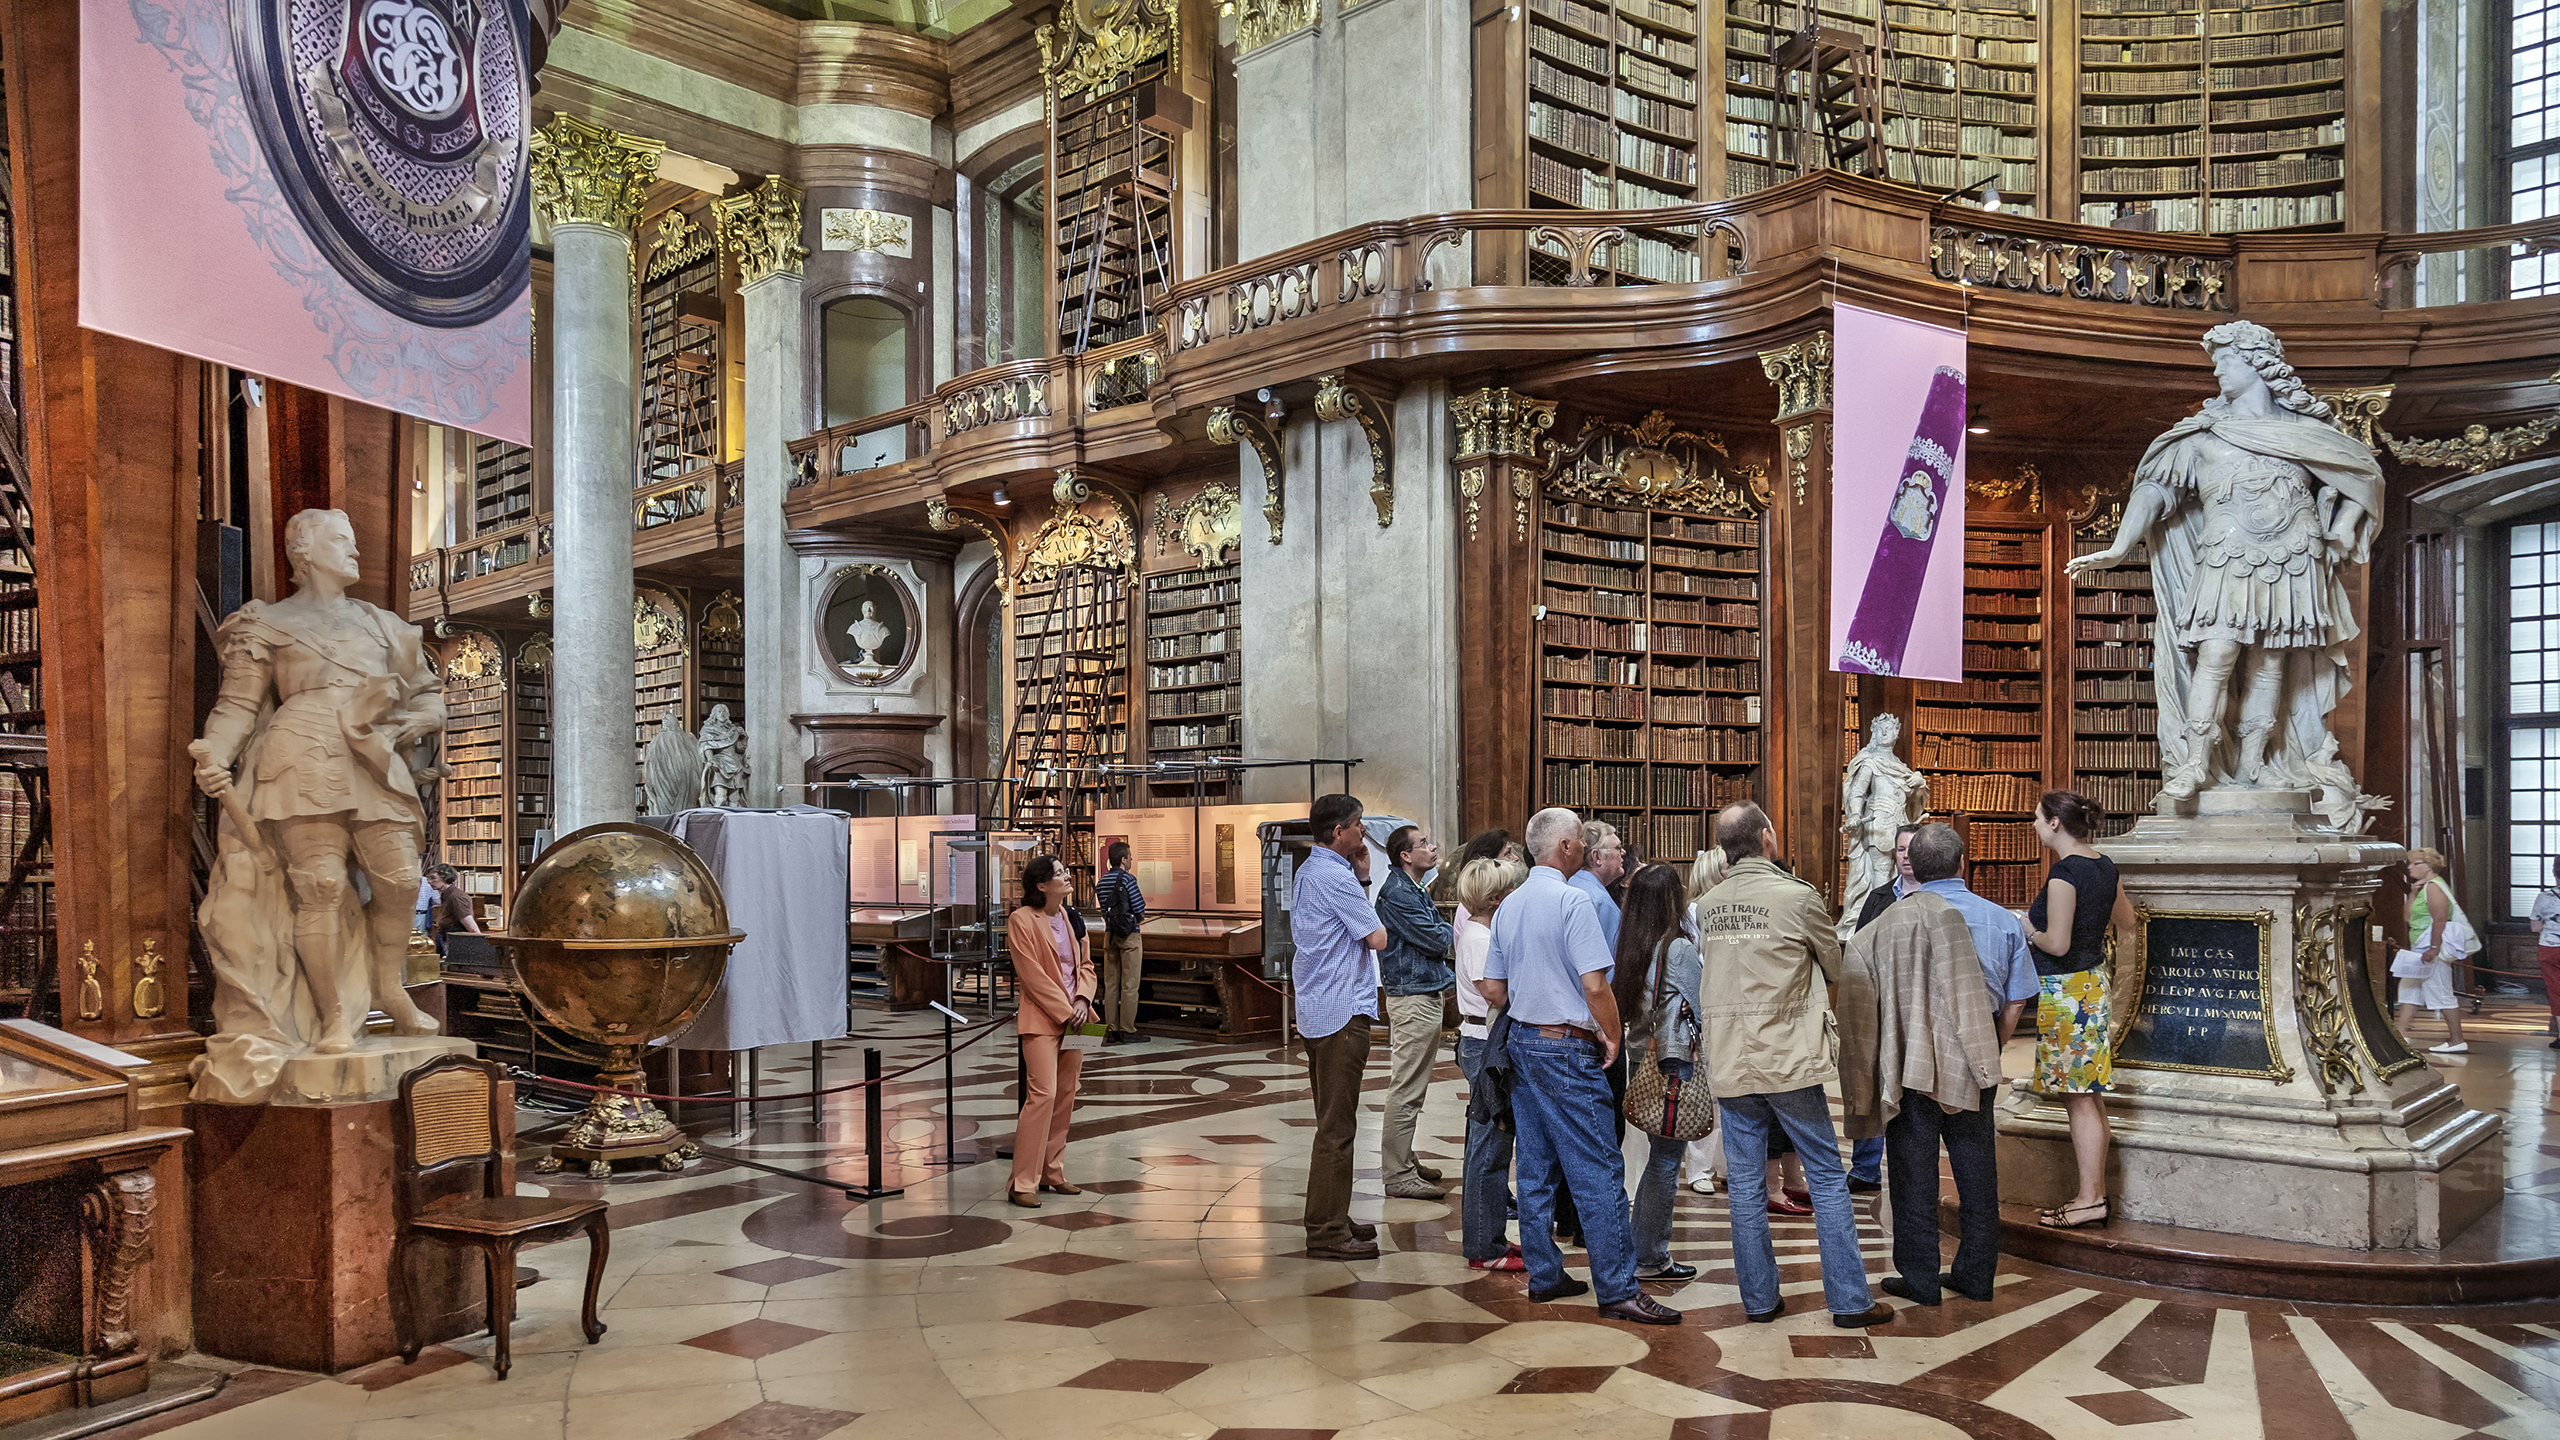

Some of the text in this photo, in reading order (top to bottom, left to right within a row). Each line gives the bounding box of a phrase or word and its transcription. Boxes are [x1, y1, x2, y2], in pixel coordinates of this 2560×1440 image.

[352, 160, 375, 189] am
[391, 200, 440, 229] April
[440, 200, 474, 226] 1854
[1731, 904, 1770, 918] TRAVEL
[1712, 914, 1754, 925] CAPTURE
[1704, 922, 1770, 935] NTIONAL PARK
[2149, 966, 2206, 978] CAROLO
